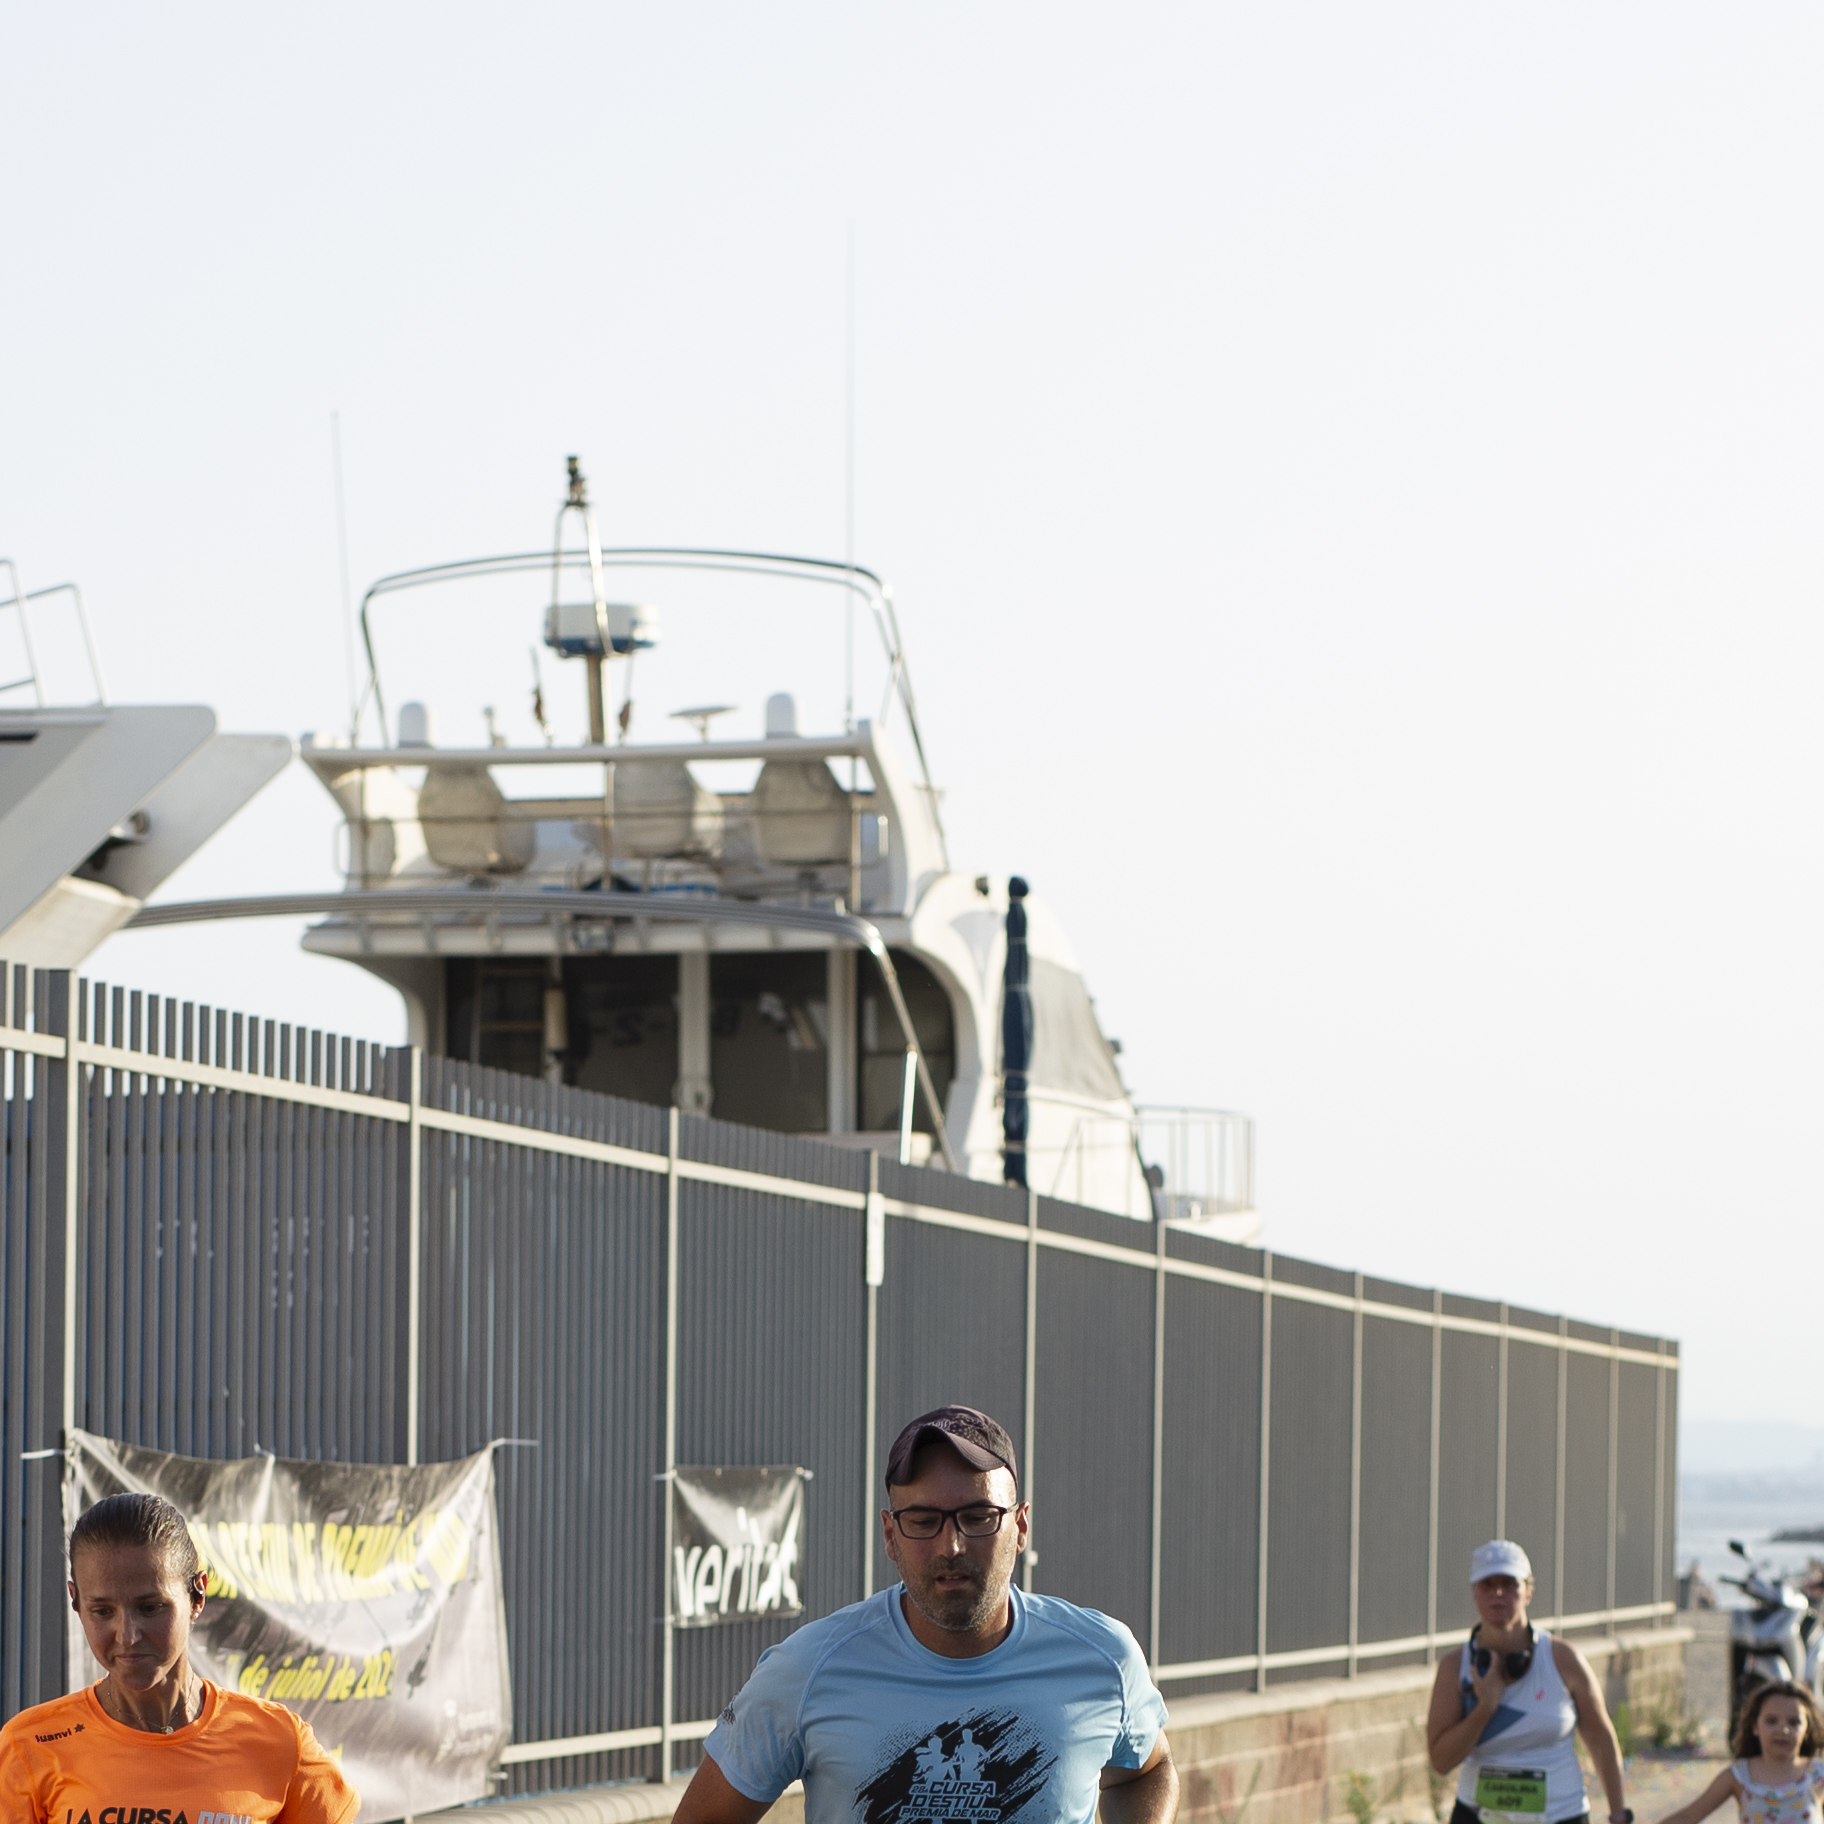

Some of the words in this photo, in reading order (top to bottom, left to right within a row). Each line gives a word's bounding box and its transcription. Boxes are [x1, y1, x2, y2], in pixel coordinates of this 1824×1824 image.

[35, 1728, 72, 1743] luanvi
[929, 1782, 994, 1796] CURSA
[912, 1796, 985, 1809] D'ESTIU
[951, 1808, 969, 1818] DE
[970, 1809, 999, 1819] MAR
